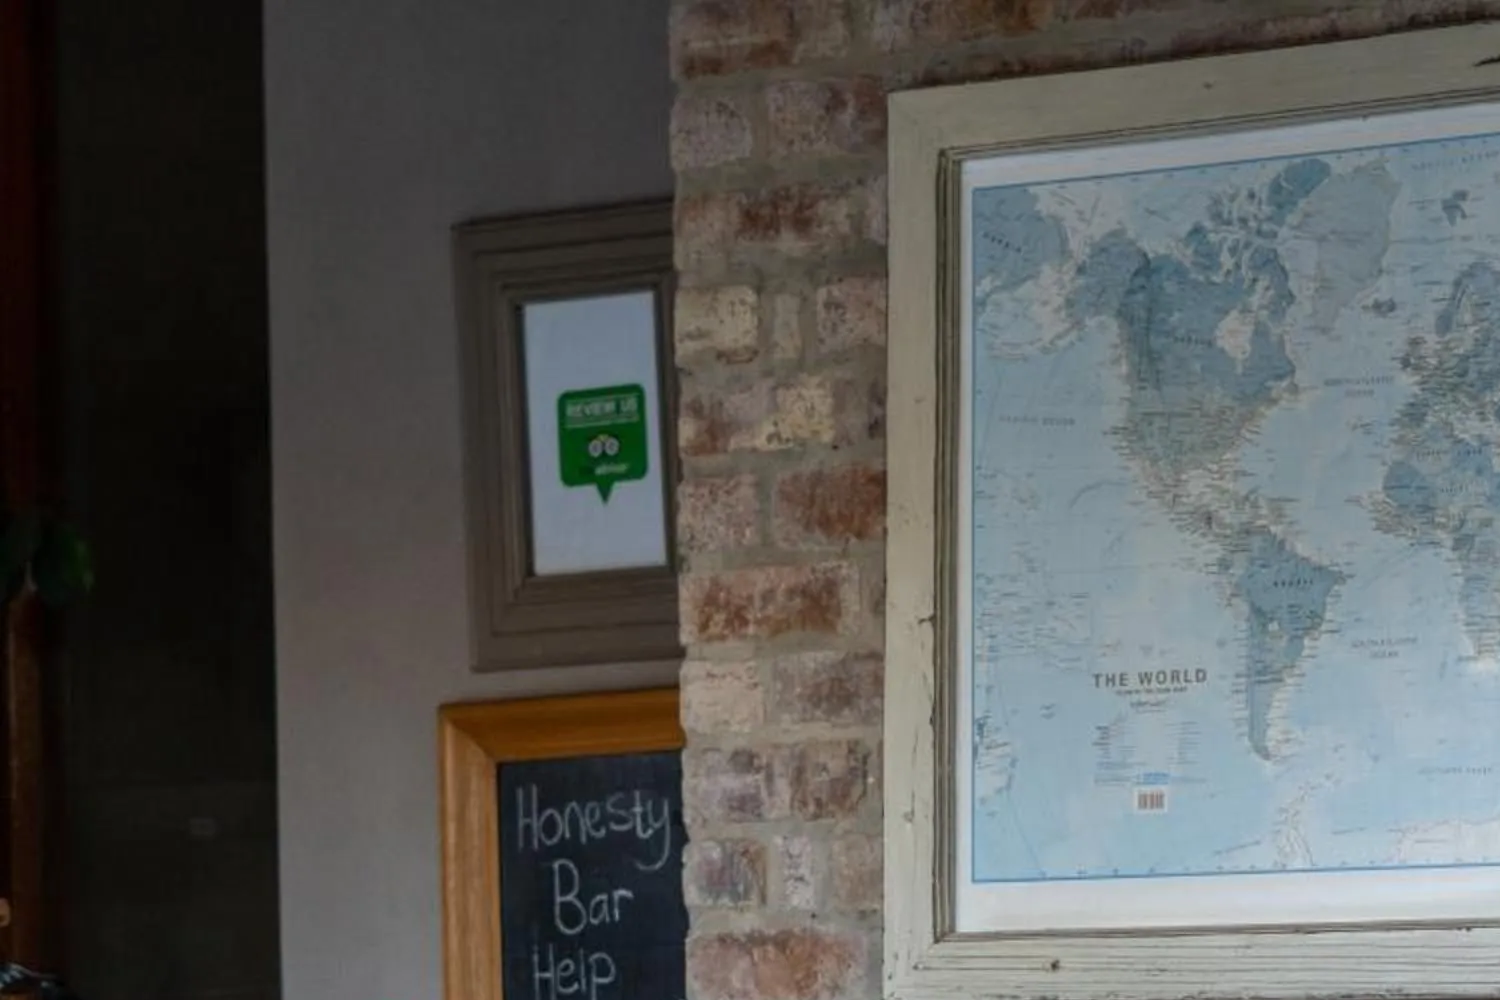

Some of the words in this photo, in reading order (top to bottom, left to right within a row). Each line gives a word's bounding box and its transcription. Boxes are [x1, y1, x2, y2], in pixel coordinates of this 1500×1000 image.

[1092, 671, 1129, 689] THE
[1137, 668, 1208, 686] WORLD
[515, 784, 671, 871] Honesty
[552, 858, 634, 936] Bar
